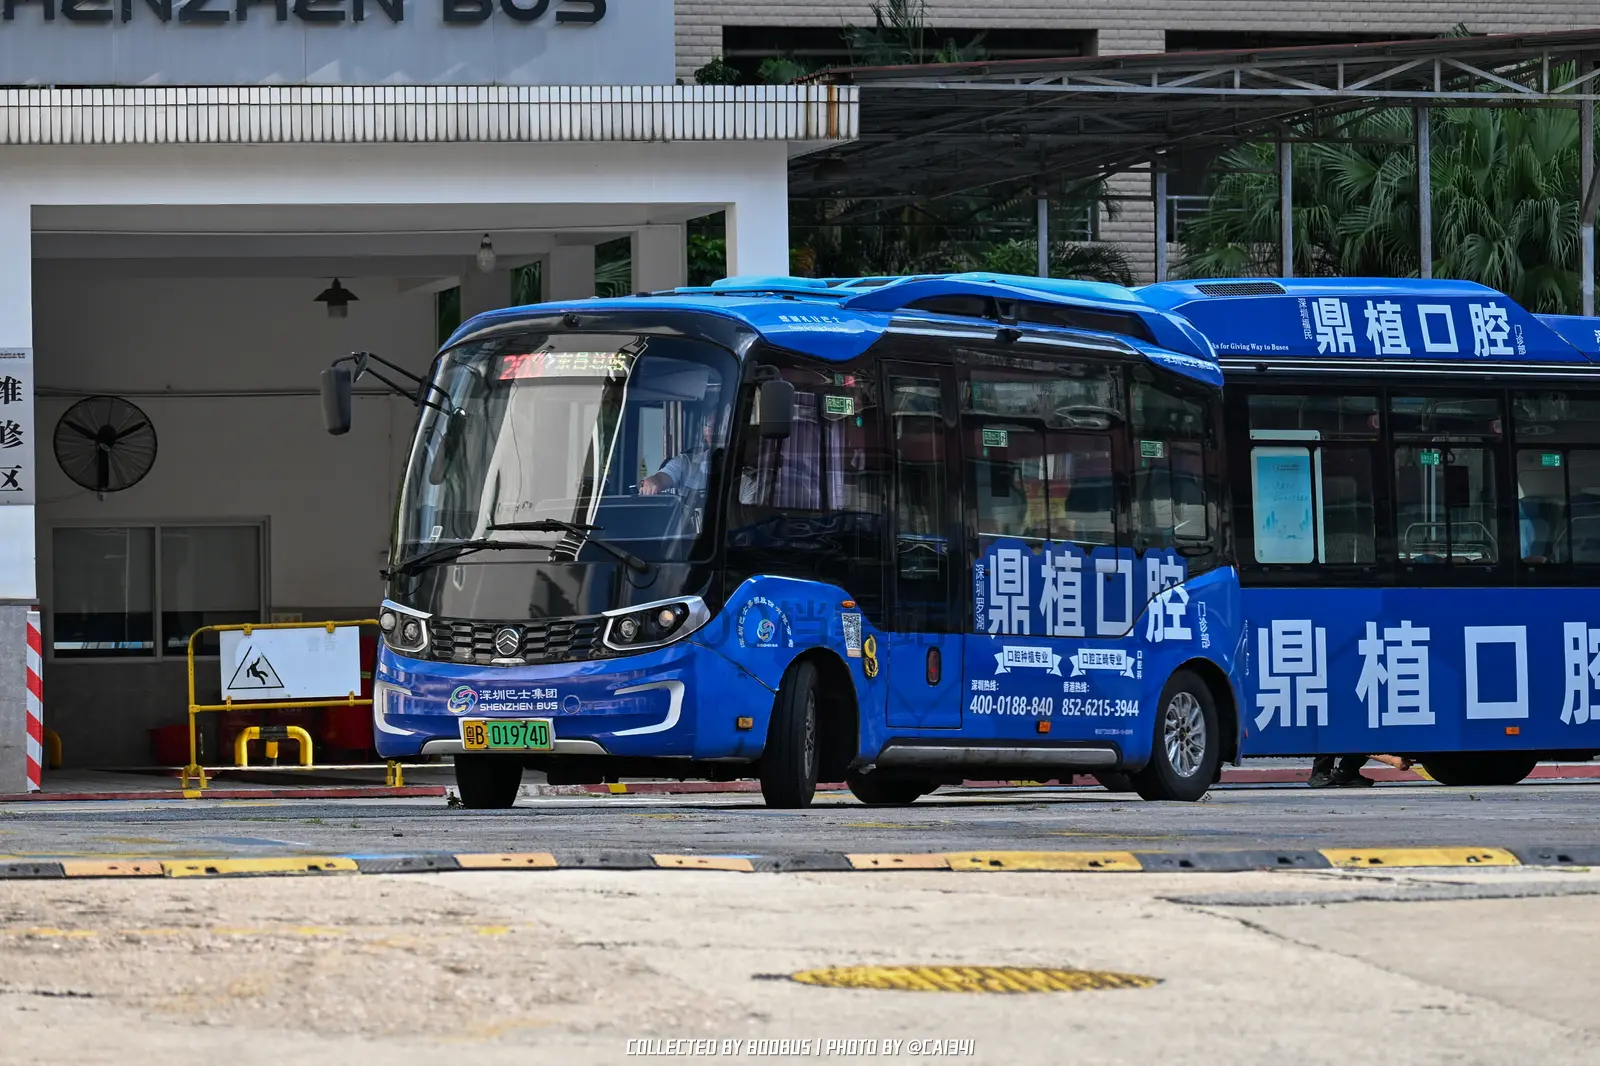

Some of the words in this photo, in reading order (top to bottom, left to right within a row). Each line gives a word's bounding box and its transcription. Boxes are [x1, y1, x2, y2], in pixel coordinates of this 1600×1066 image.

[1312, 298, 1514, 357] 鼎植口腔
[1220, 342, 1229, 350] for
[1230, 342, 1250, 352] Giving
[1250, 343, 1263, 352] Way
[1271, 343, 1289, 351] Buses
[987, 548, 1192, 643] 鼎植口腔
[1007, 650, 1049, 664] 口腔种植专业
[479, 688, 558, 701] 深圳巴士集团
[479, 702, 534, 712] SHENZHEN
[537, 701, 558, 710] BUS
[969, 695, 1054, 716] 400-0188-840
[1061, 698, 1140, 717] 852-6215-3944
